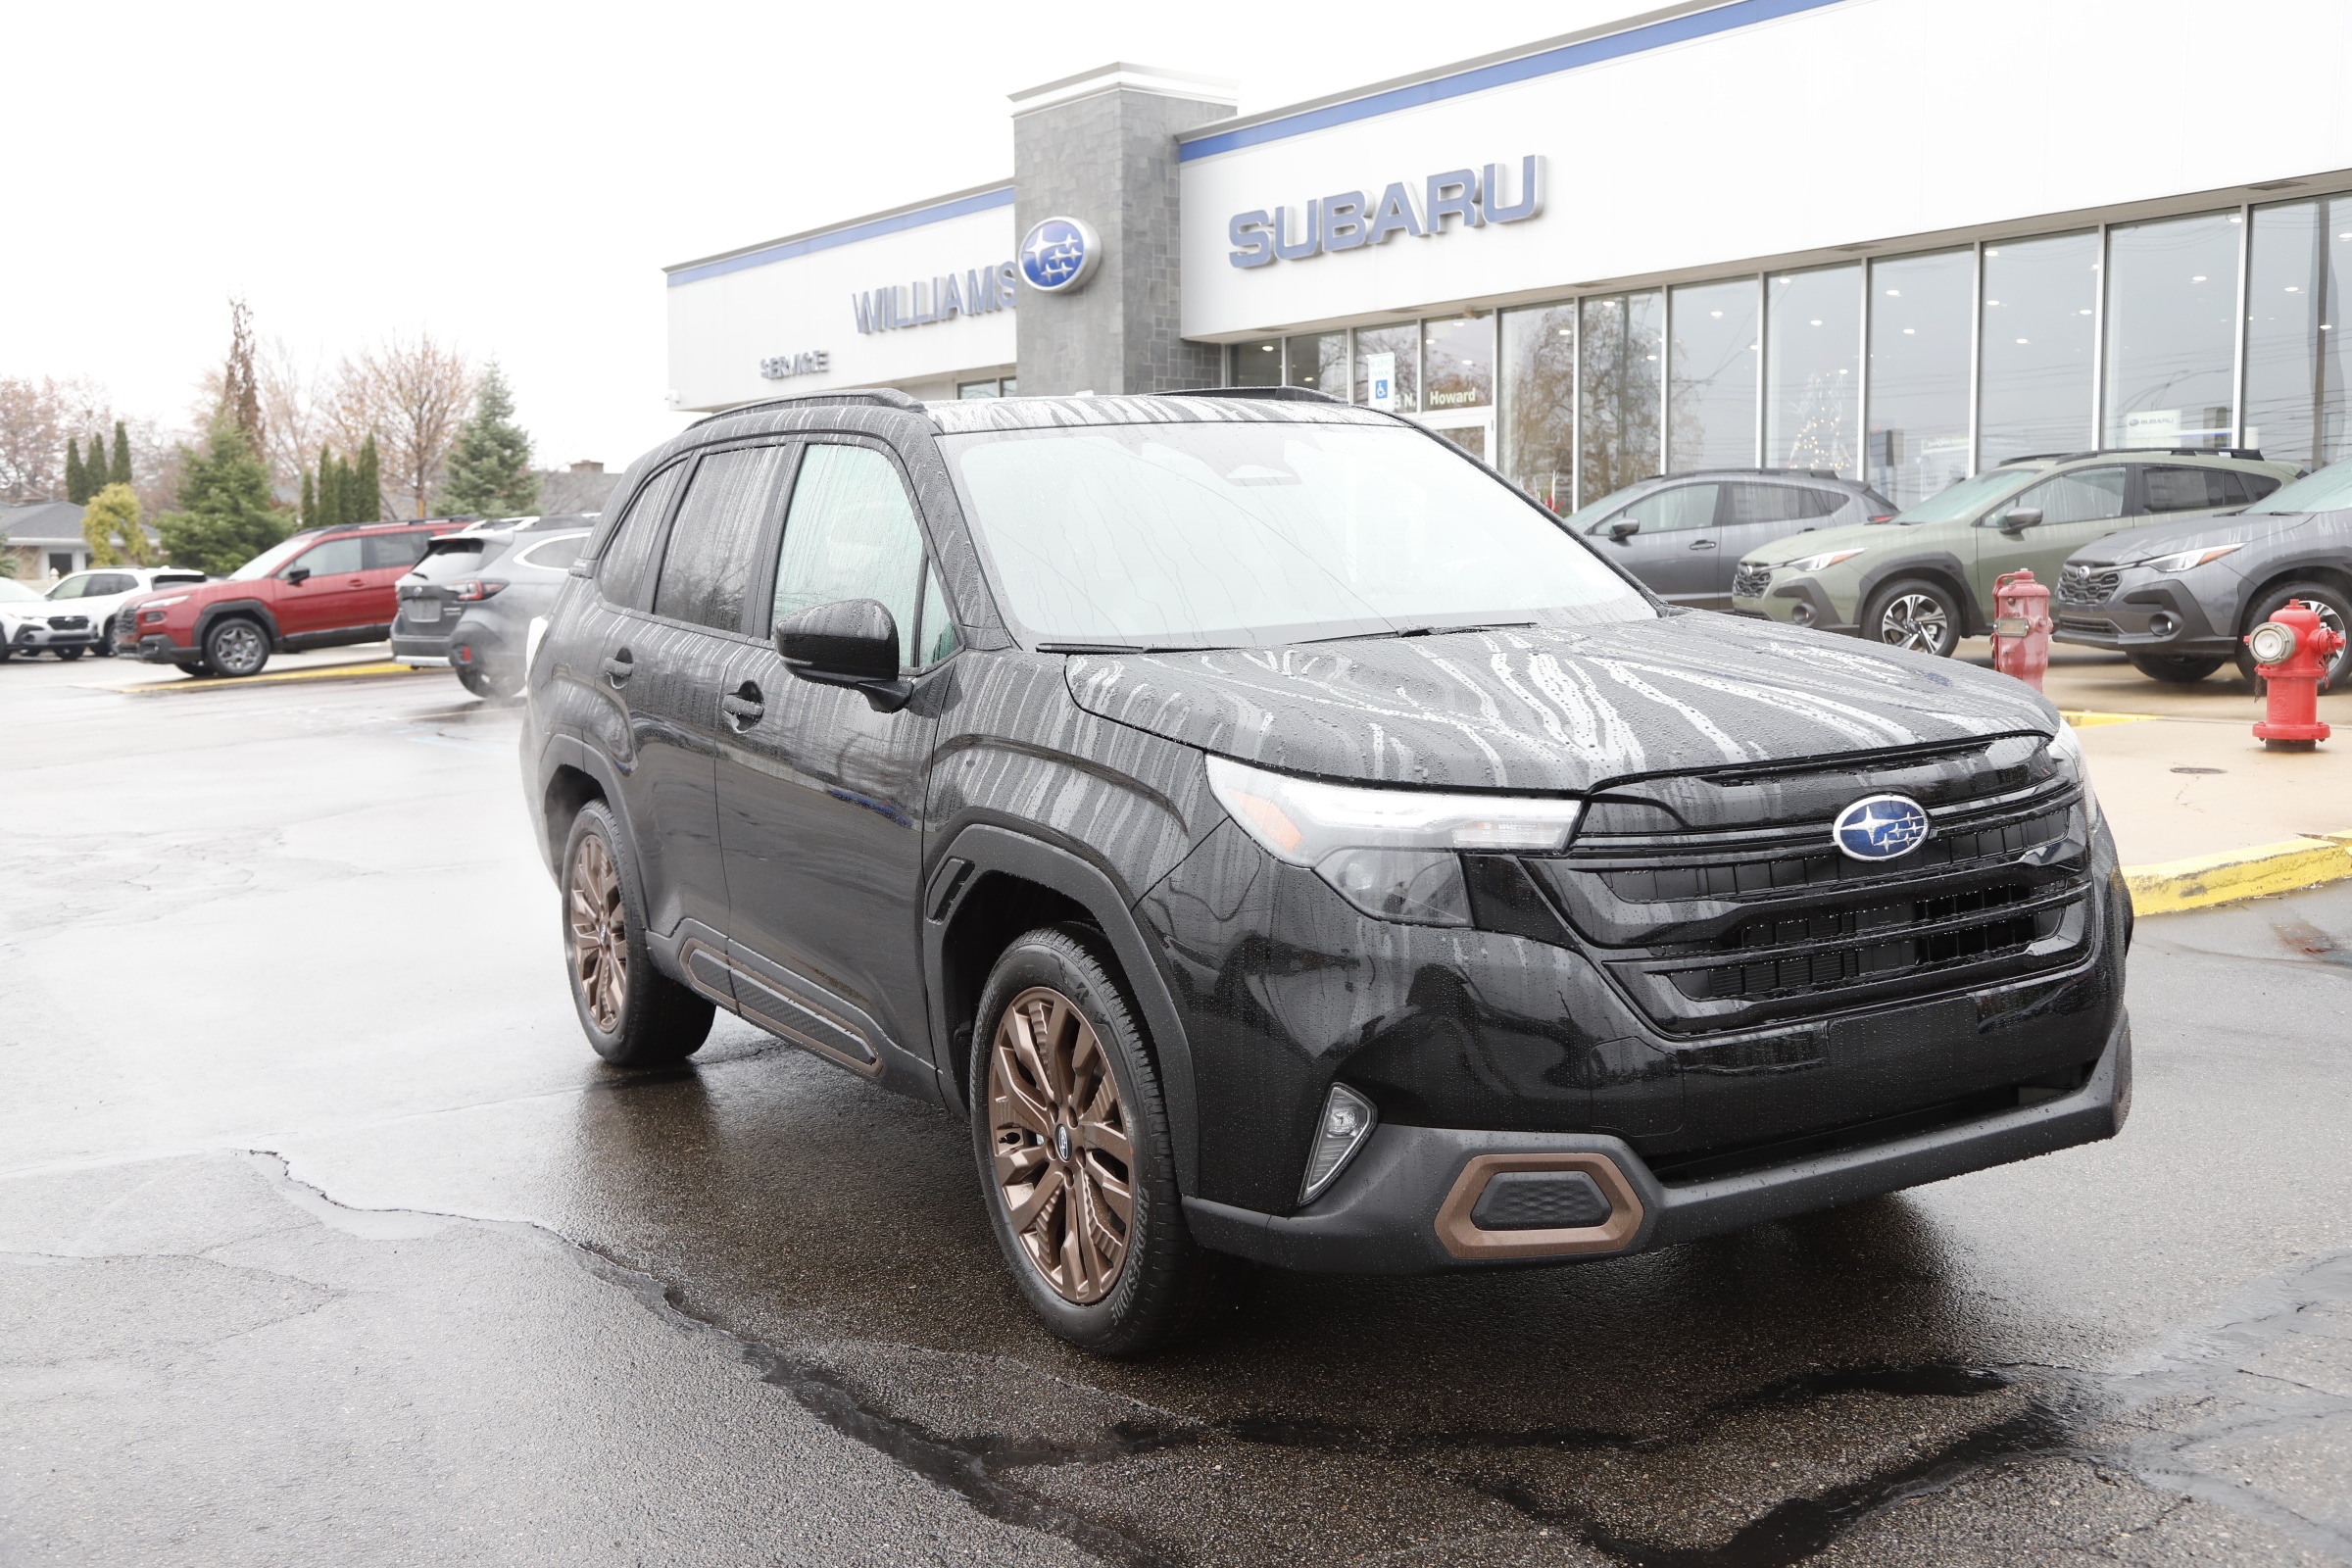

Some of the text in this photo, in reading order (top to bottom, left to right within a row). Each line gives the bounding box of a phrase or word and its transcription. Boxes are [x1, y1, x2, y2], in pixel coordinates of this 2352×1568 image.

[1229, 155, 1544, 269] SUBARU
[853, 261, 1016, 334] WILLIAMS
[760, 350, 830, 380] SERVICE
[1404, 393, 1417, 407] N.
[1430, 387, 1477, 406] Howard
[1109, 1182, 1150, 1326] BRIDGESTONE
